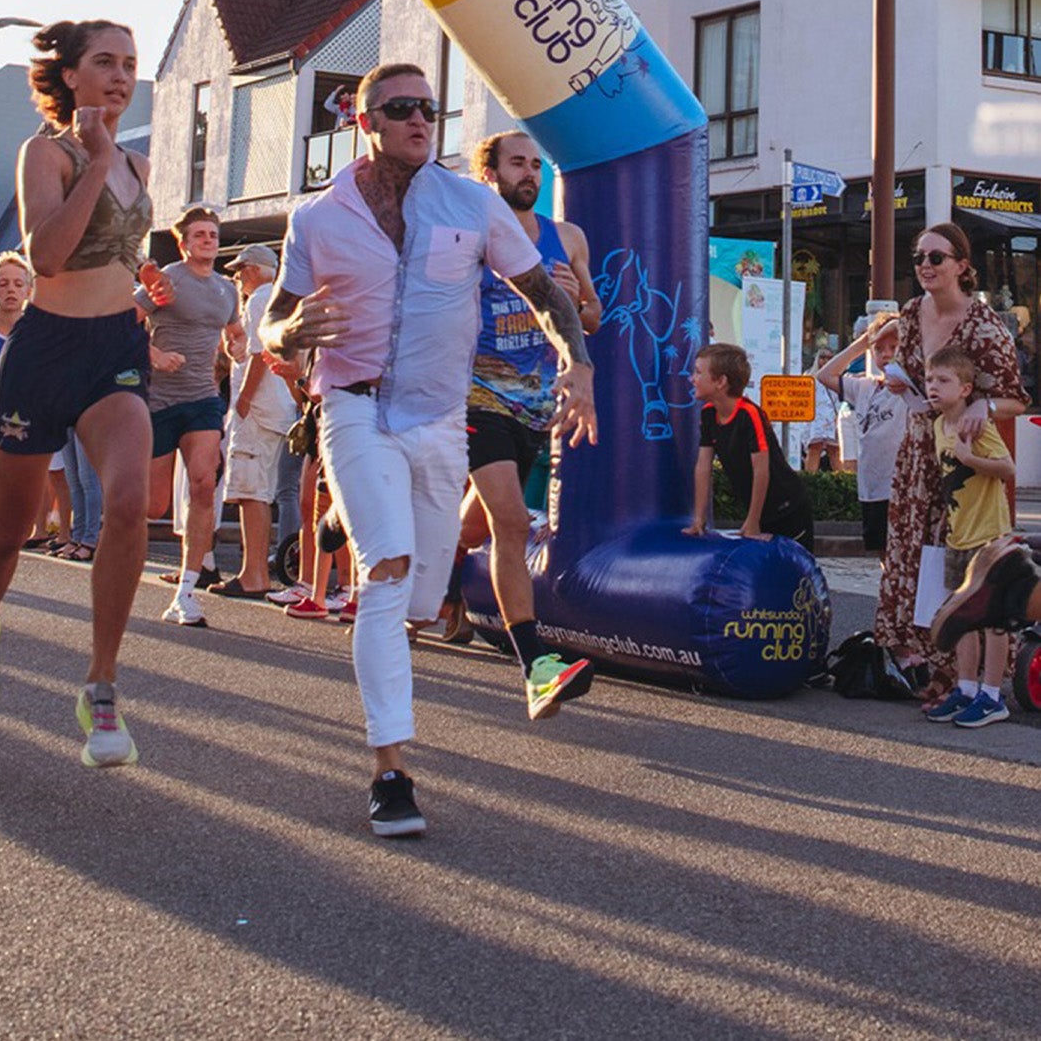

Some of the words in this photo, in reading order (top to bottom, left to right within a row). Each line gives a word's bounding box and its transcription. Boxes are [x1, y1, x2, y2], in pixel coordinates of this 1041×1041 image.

[973, 180, 1016, 200] Exclusive
[955, 194, 983, 209] BODY
[984, 198, 1034, 213] PRODUCTS
[781, 410, 806, 418] CLEAR
[740, 607, 805, 623] whitsunday
[723, 621, 806, 645] running
[761, 639, 804, 661] club
